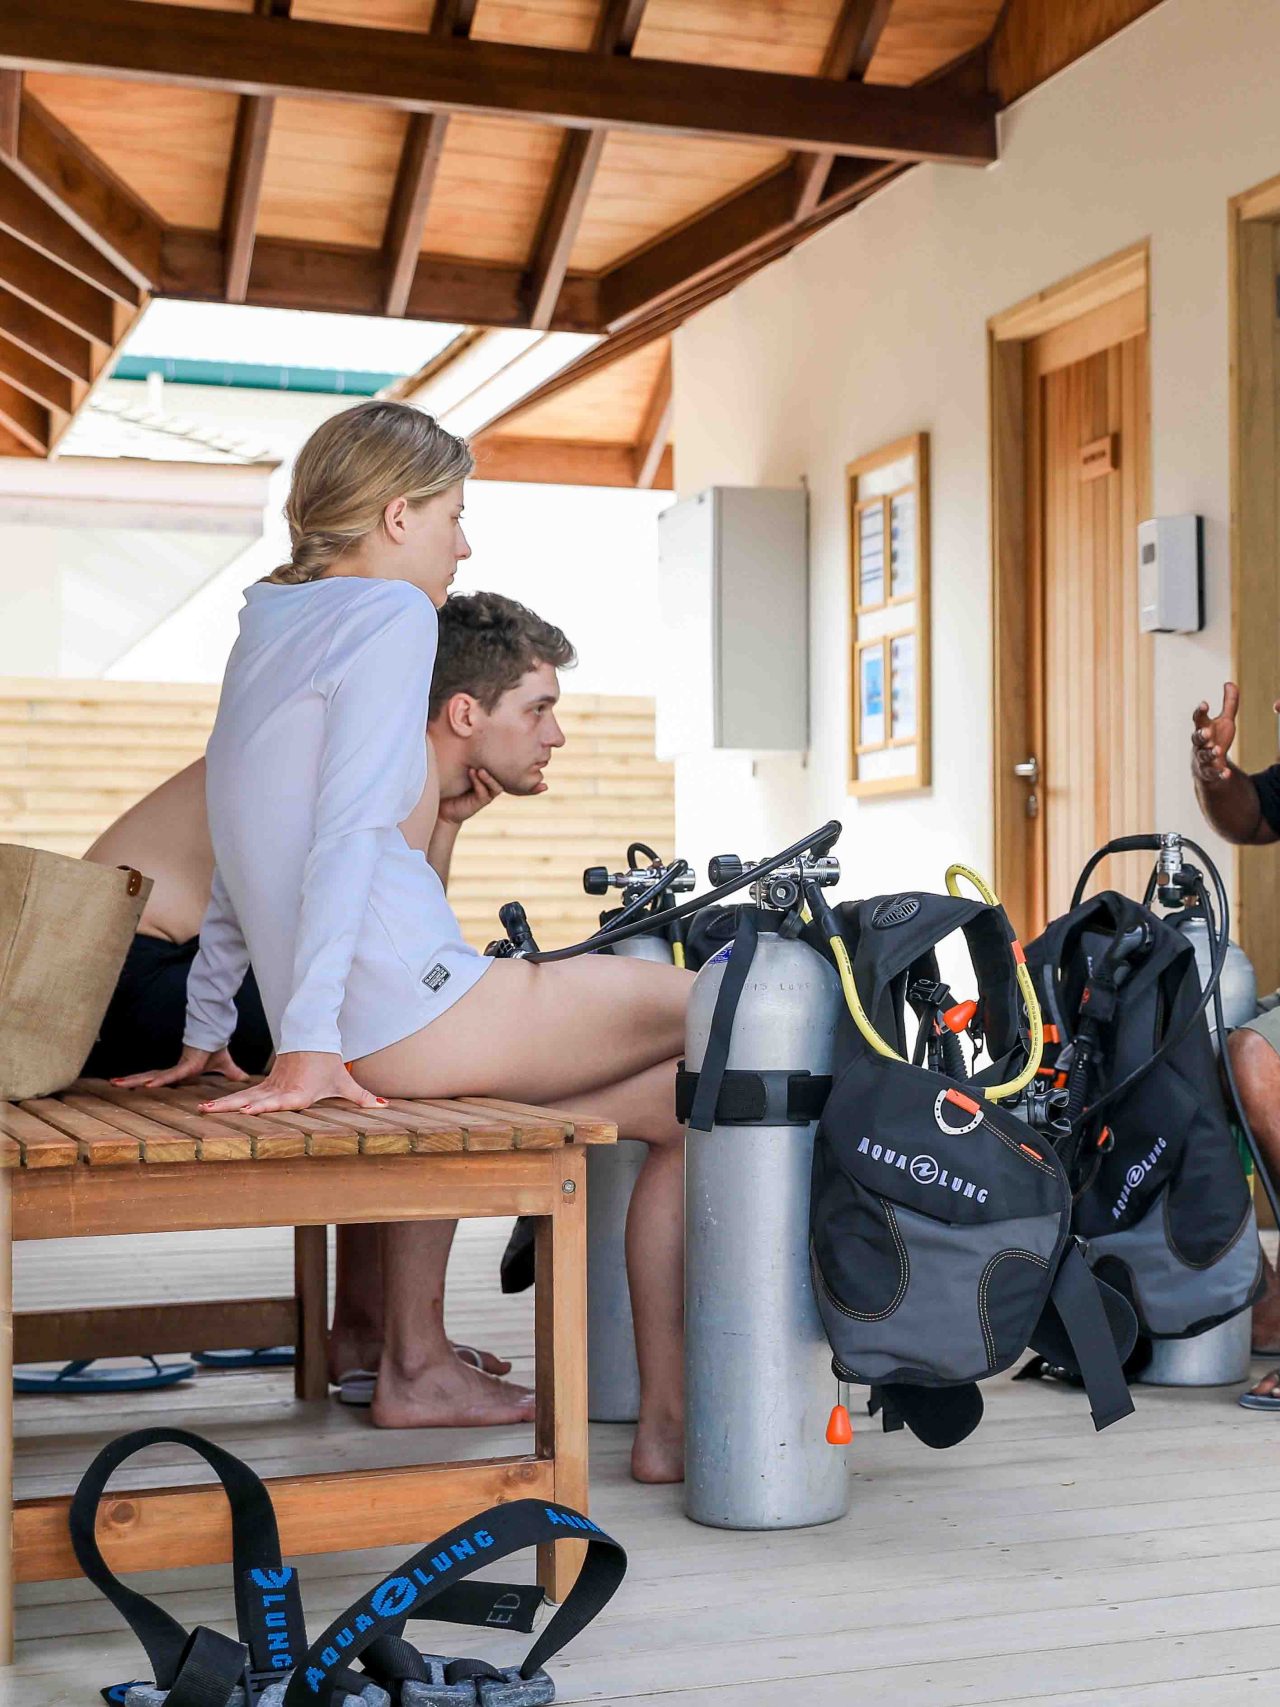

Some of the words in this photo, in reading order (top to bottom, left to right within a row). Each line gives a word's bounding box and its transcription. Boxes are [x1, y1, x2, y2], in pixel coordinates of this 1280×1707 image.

[857, 1136, 908, 1170] AQUA
[938, 1169, 989, 1204] LUNG
[1111, 1184, 1131, 1219] AQUA
[1141, 1136, 1167, 1172] LUNG
[262, 1594, 293, 1669] LUNG
[305, 1613, 375, 1693] AQUA
[412, 1529, 495, 1586] LUNG
